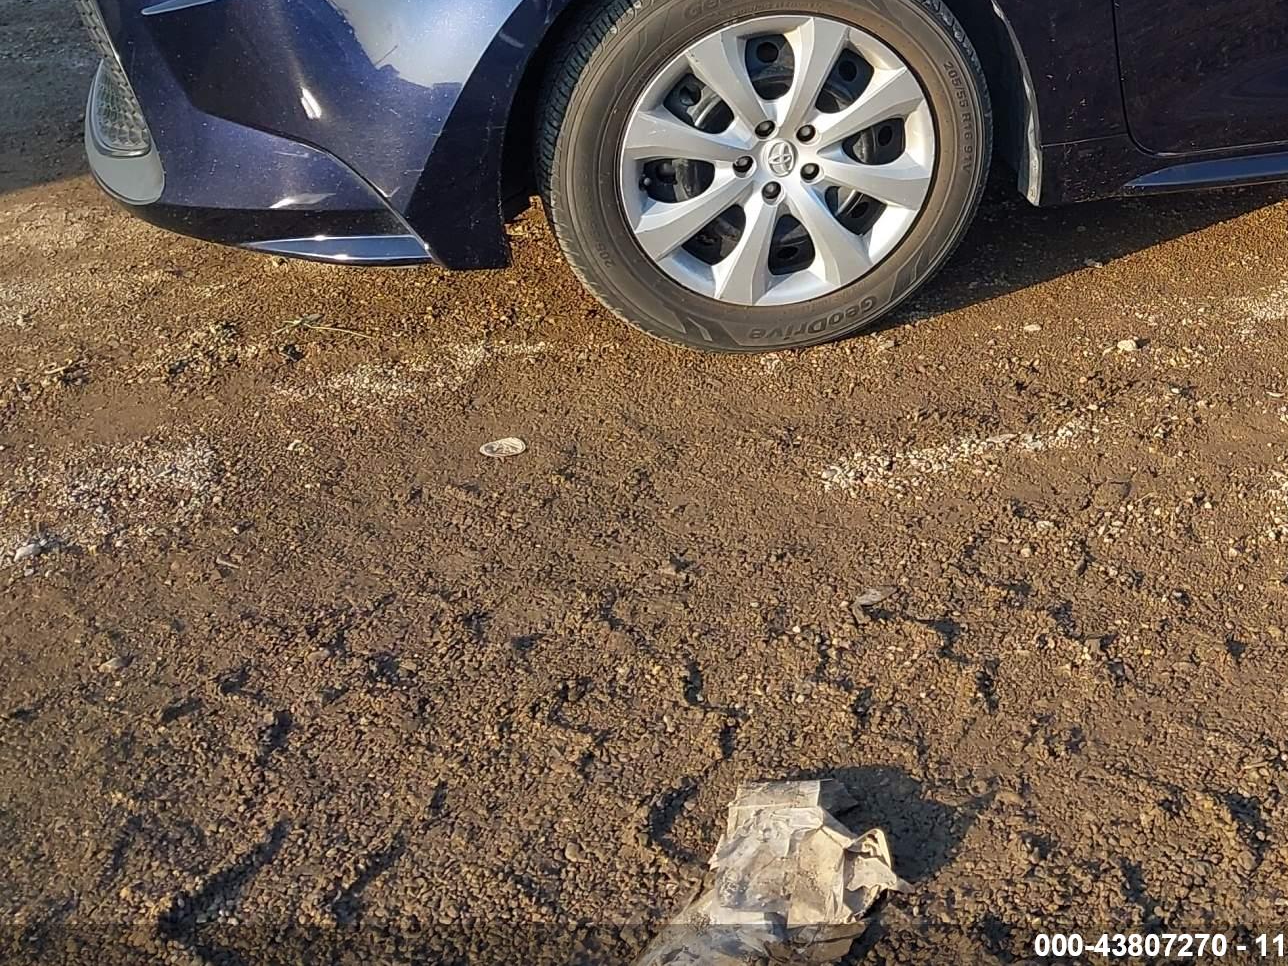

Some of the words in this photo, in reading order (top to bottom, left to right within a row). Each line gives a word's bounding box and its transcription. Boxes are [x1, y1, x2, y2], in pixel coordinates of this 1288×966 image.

[943, 61, 969, 108] 205/55
[960, 112, 973, 140] R16
[962, 145, 974, 175] 91V
[748, 295, 878, 341] GeoDrive
